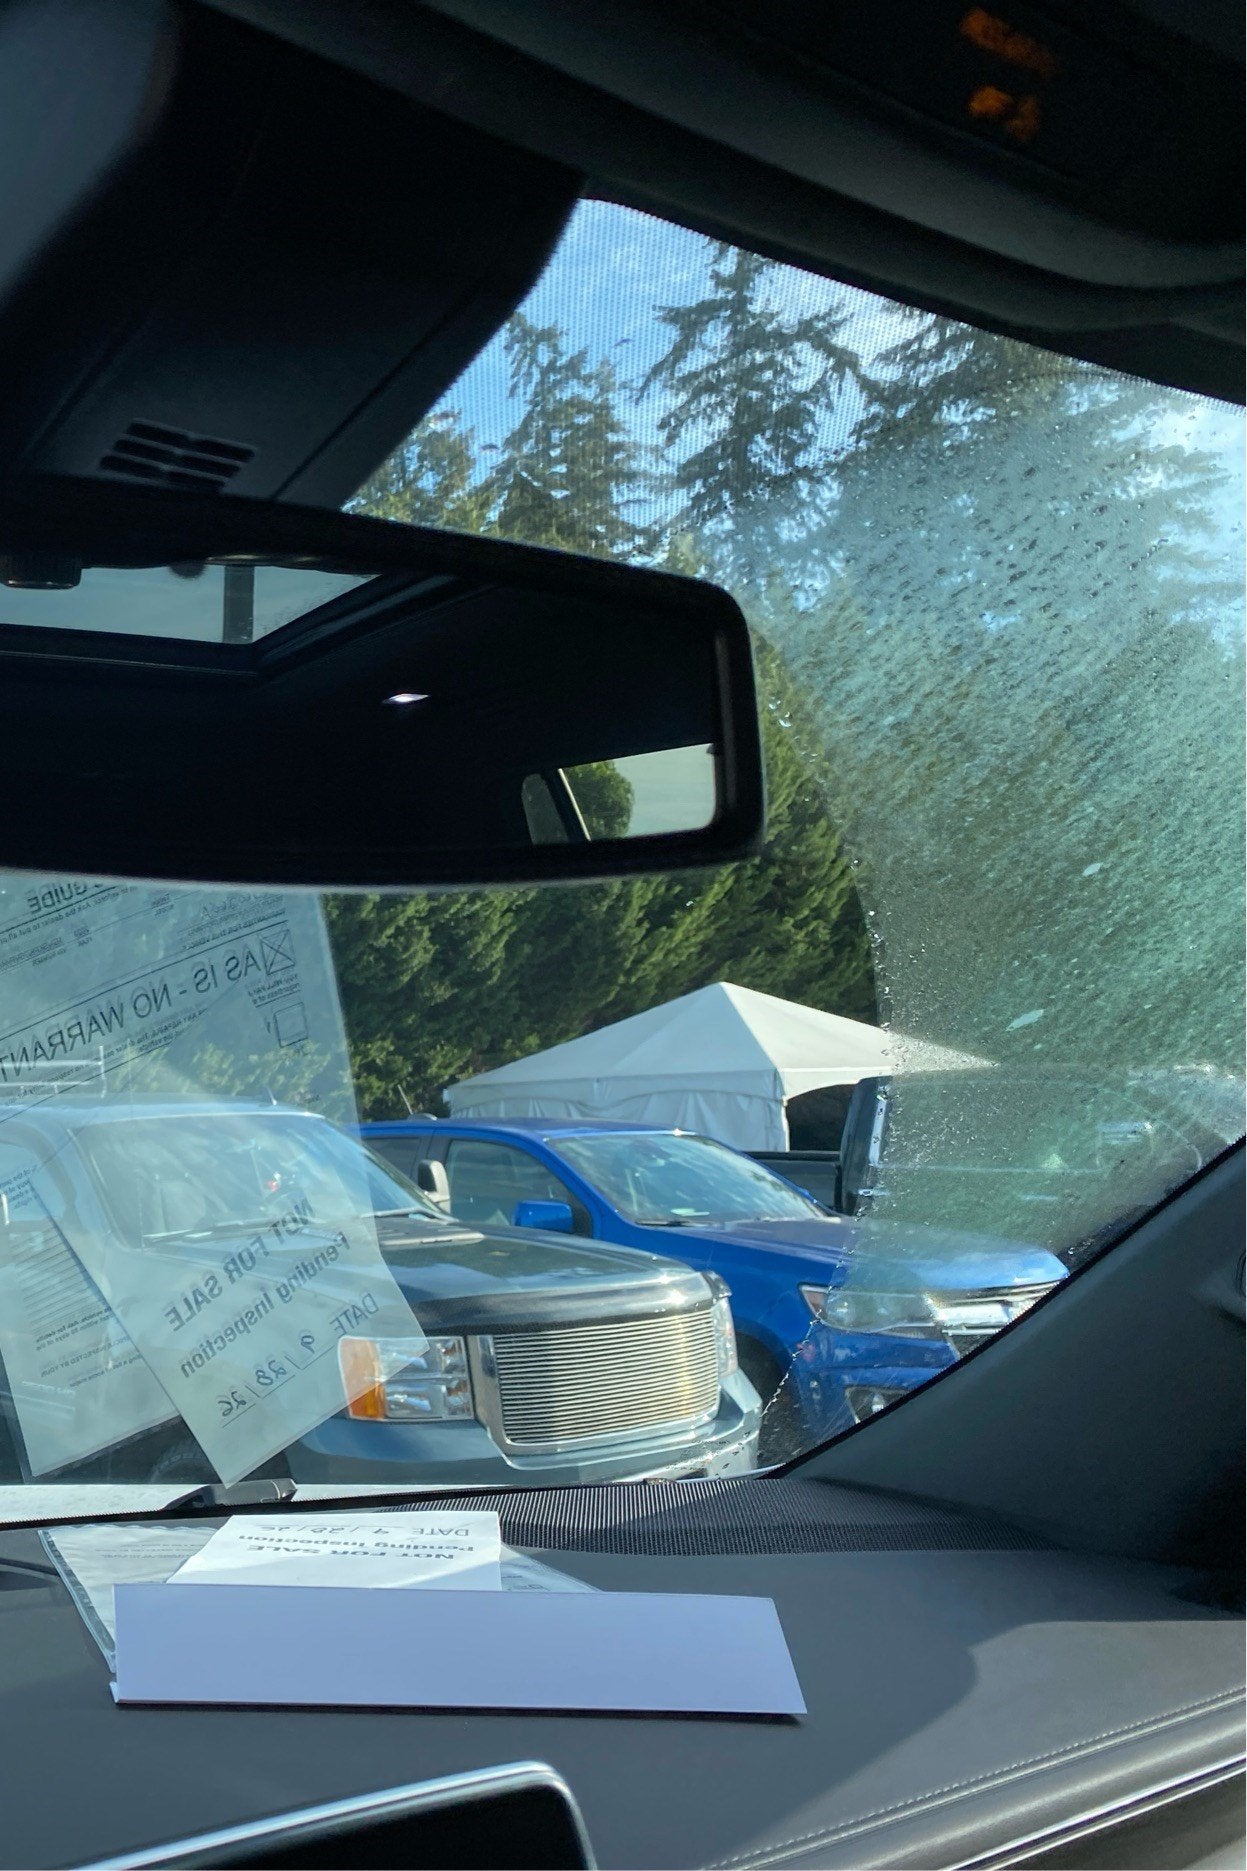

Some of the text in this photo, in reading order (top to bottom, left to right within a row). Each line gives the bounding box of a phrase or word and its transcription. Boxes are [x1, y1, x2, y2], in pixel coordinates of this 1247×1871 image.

[411, 1527, 470, 1537] DATE
[238, 1536, 474, 1552] Pending Inspection
[246, 1544, 320, 1554] SALE
[394, 1552, 454, 1560] NOT
